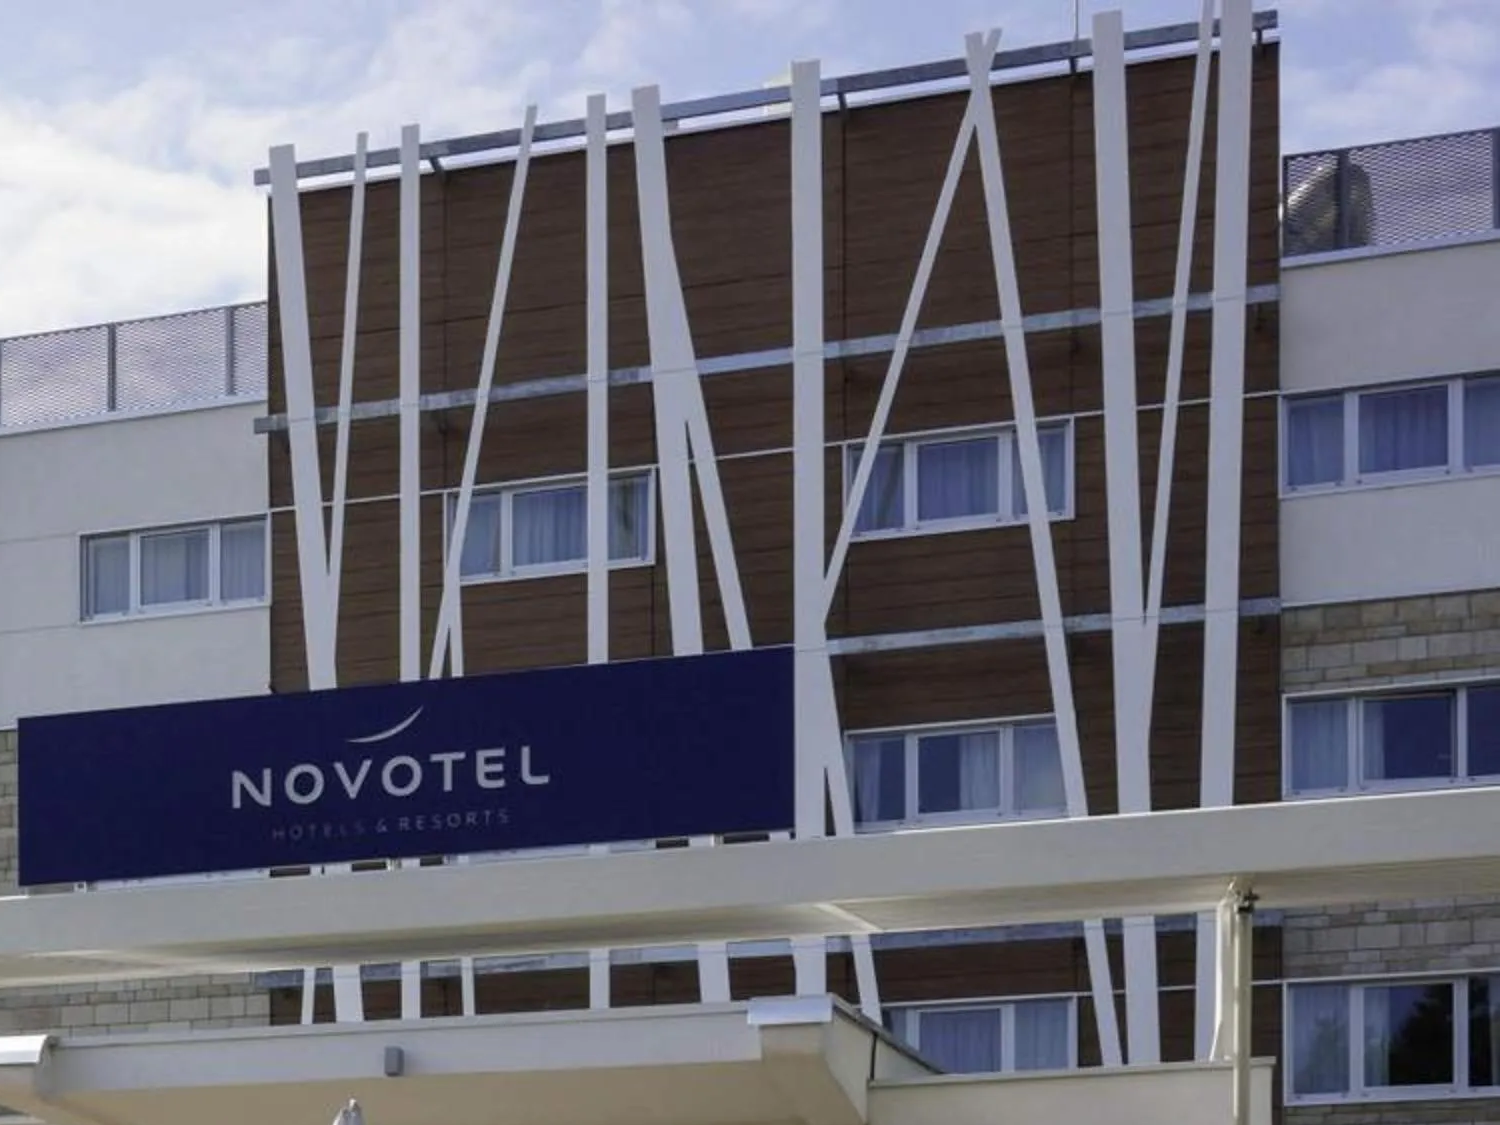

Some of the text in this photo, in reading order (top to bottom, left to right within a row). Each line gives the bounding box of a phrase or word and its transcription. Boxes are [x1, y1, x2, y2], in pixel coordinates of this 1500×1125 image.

[231, 745, 550, 809] NOVOTEL
[271, 808, 509, 841] HOTELS & RESORTS
